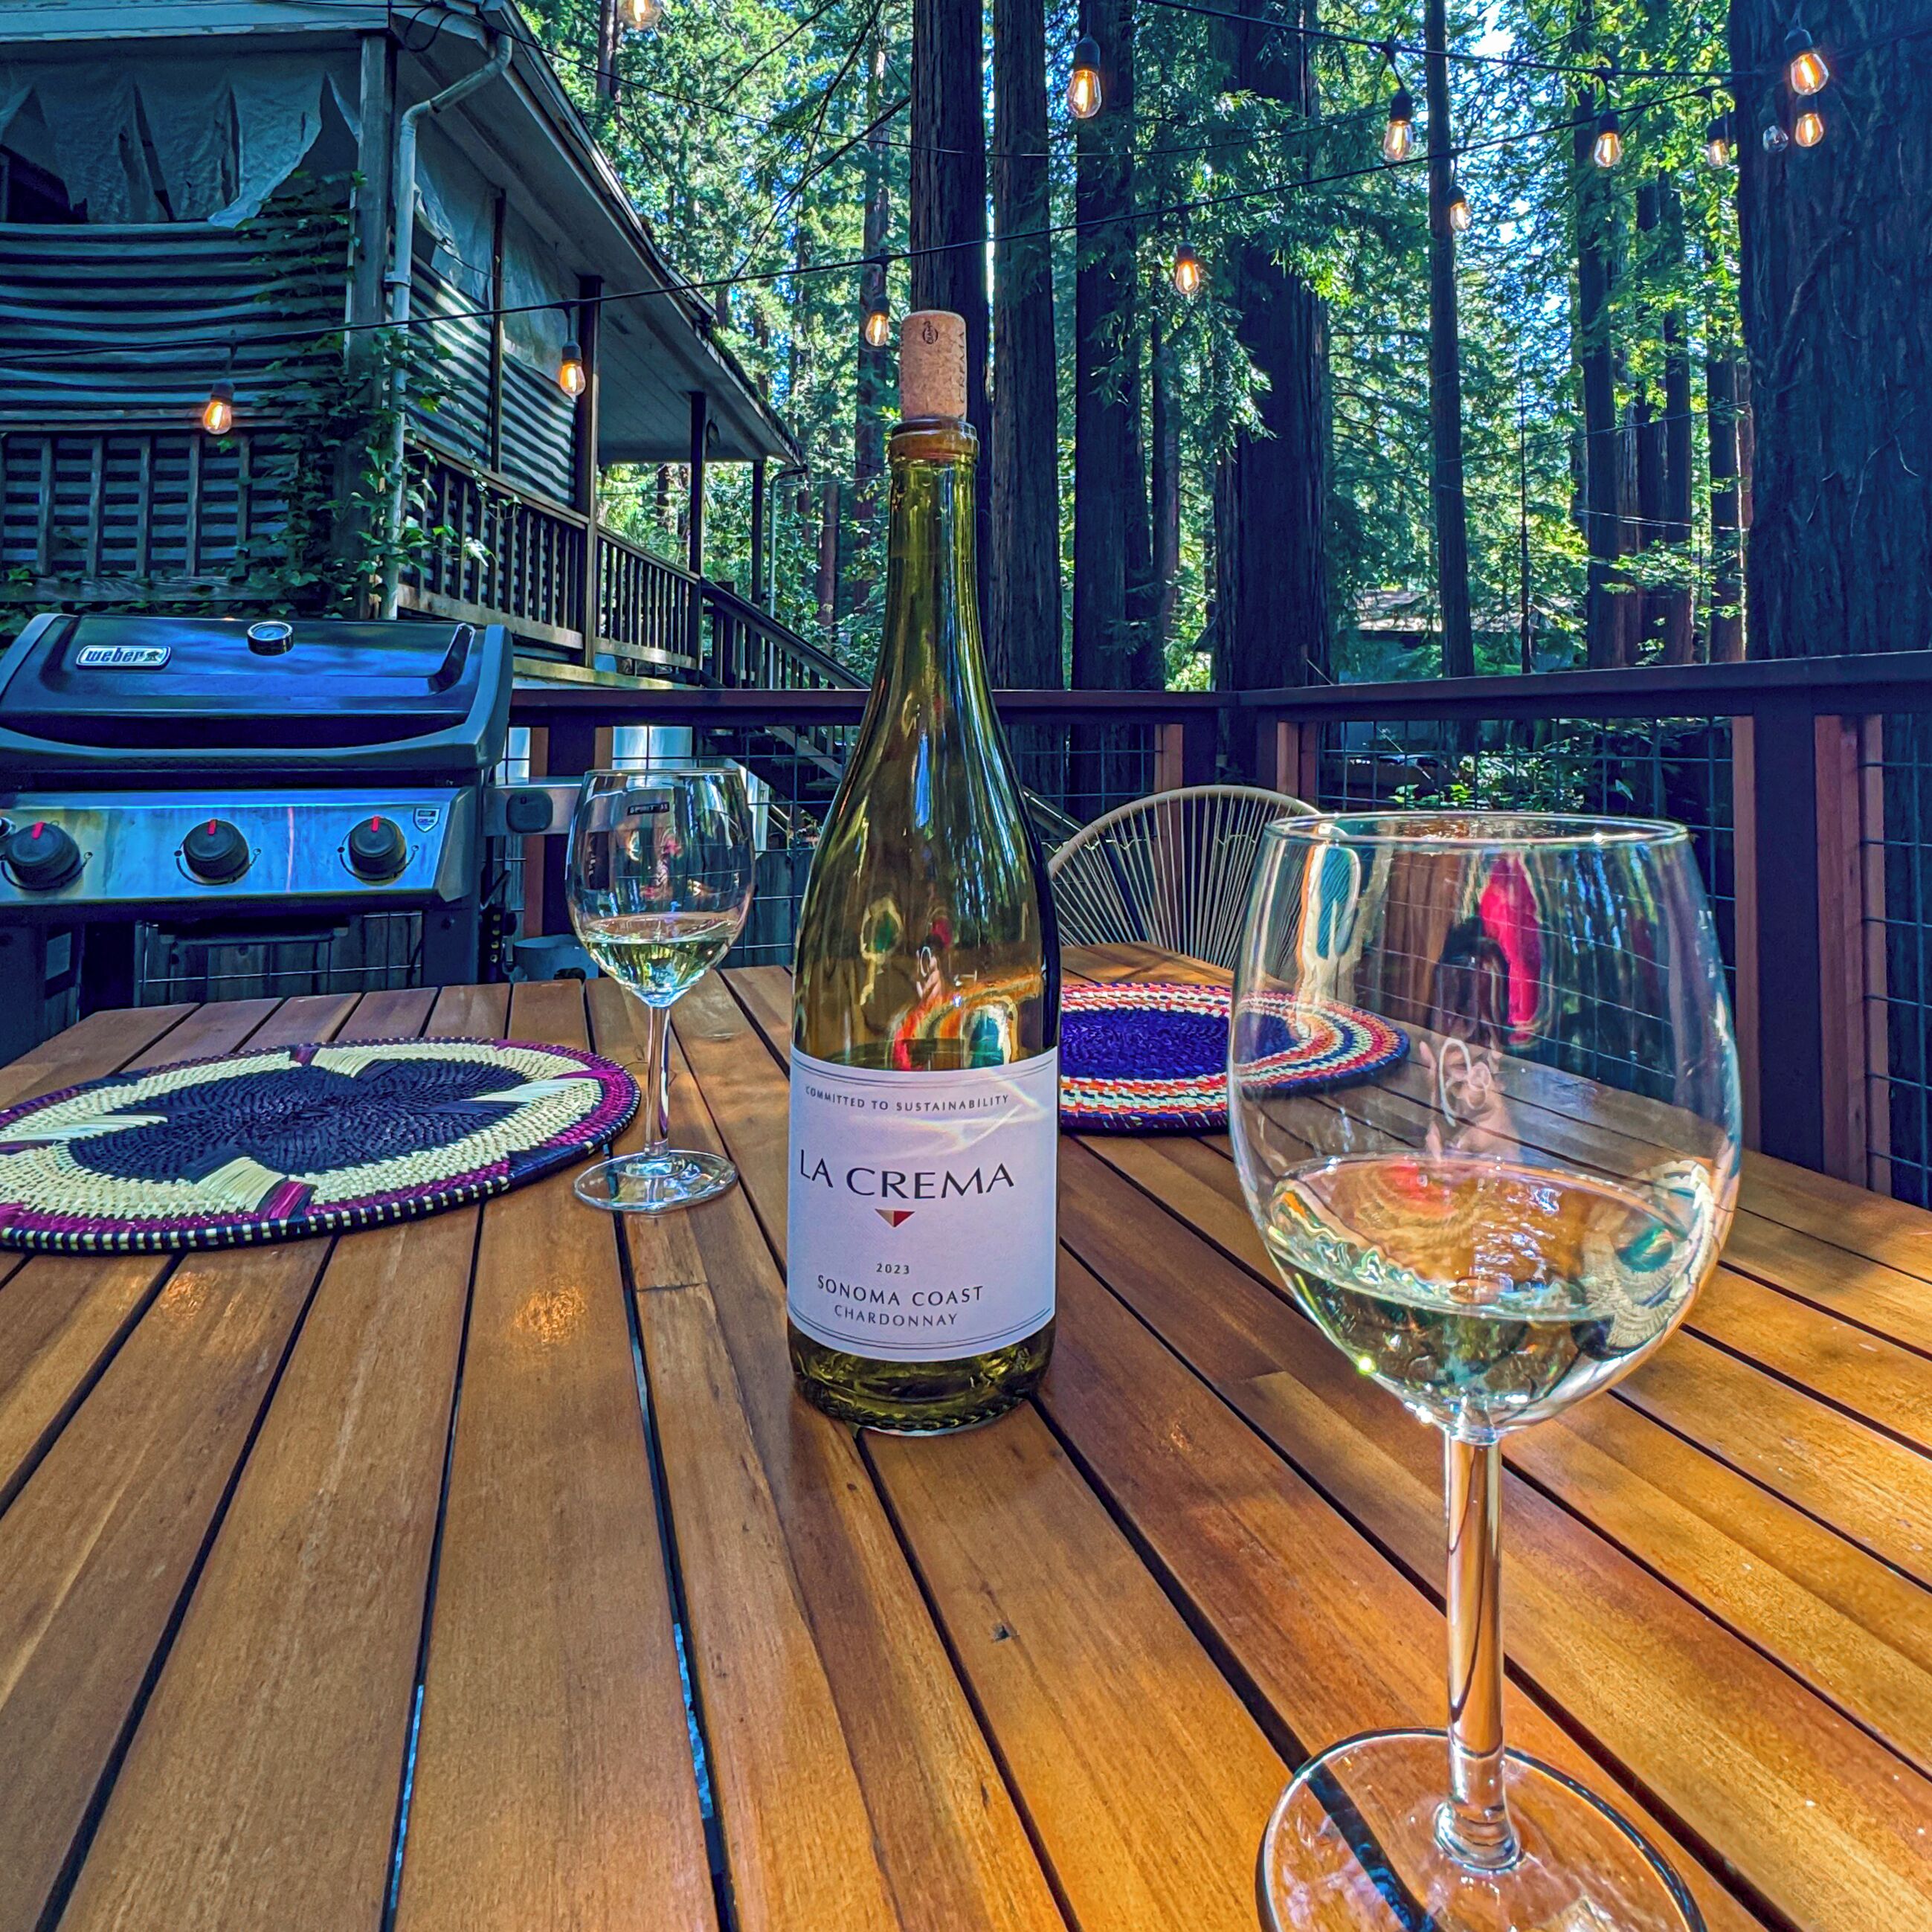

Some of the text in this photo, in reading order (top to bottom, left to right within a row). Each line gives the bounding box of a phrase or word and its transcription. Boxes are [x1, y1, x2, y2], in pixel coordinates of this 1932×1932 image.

[86, 647, 145, 663] weber
[805, 1086, 1008, 1112] COMMITTED TO SUSTAINABILITY
[801, 1149, 1014, 1200] LA CREMA
[876, 1263, 909, 1275] 2023
[817, 1274, 984, 1307] SONOMA COAST
[834, 1304, 958, 1327] CHARDONNAY
